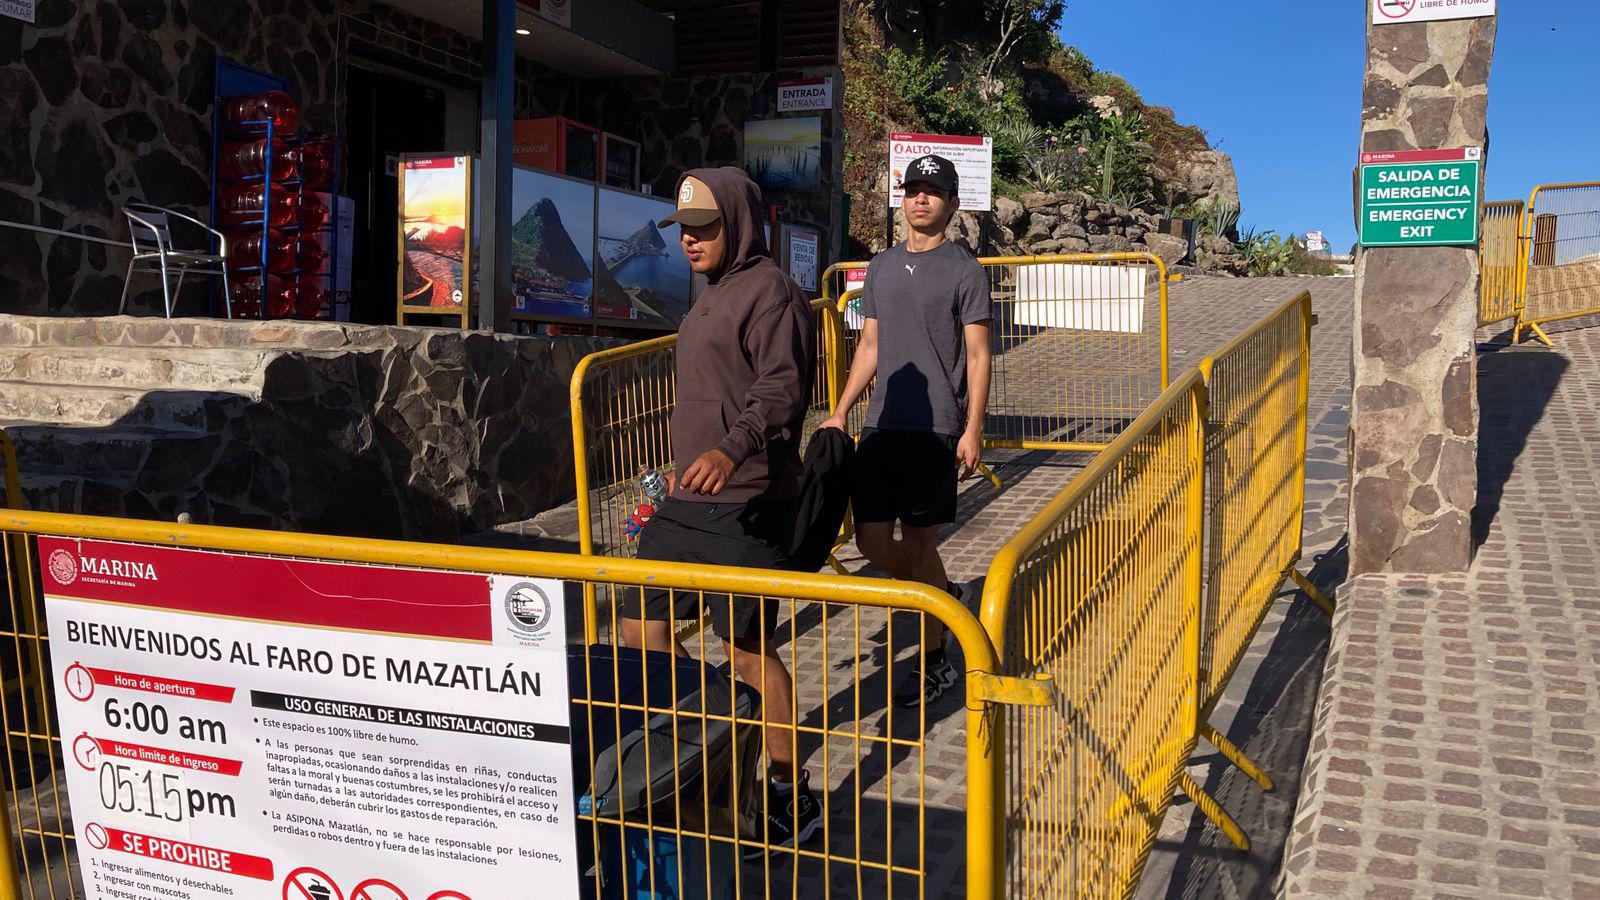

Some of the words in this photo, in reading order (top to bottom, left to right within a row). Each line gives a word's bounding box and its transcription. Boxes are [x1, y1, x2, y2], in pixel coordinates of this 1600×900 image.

[782, 89, 826, 98] ENTRADA
[782, 99, 826, 108] ENTRANCE
[905, 146, 931, 154] ALTO
[1378, 170, 1434, 182] SALIDA
[1438, 168, 1460, 180] DE
[1367, 185, 1471, 199] EMERGENCIA
[1370, 208, 1467, 222] EMERGENCY
[1400, 226, 1434, 237] EXIT
[794, 243, 807, 252] VENTA
[794, 253, 813, 264] BEBIDAS
[80, 556, 158, 580] MARINA
[66, 620, 222, 662] BIENVENIDOS
[230, 641, 259, 667] AL
[266, 646, 333, 674] FARO
[342, 653, 376, 680] DE
[386, 658, 541, 697] MAZATLÁN
[114, 675, 137, 689] Hora
[139, 678, 151, 690] de
[153, 682, 195, 696] apertura
[104, 698, 168, 735] 6:00
[179, 715, 227, 745] am
[263, 718, 280, 728] Este
[282, 722, 314, 734] espacio
[316, 726, 326, 734] es
[328, 726, 352, 738] 100%
[354, 729, 374, 740] libre
[376, 732, 387, 742] de
[389, 734, 418, 746] humo.
[284, 697, 311, 712] USO
[314, 701, 375, 720] GENERAL
[378, 708, 395, 722] DE
[399, 710, 422, 726] LAS
[426, 714, 535, 738] INSTALACIONES
[115, 745, 137, 757] Hora
[139, 747, 166, 763] limite
[168, 753, 180, 765] de
[183, 756, 219, 771] ingreso
[265, 738, 271, 747] A
[277, 740, 289, 750] las
[294, 744, 334, 756] personas
[339, 749, 356, 759] que
[362, 753, 383, 762] sean
[389, 756, 449, 771] sorprendidas
[456, 764, 467, 773] en
[474, 766, 500, 778] riñas,
[507, 771, 557, 784] conductas
[266, 751, 324, 768] inapropiadas,
[325, 760, 381, 774] ocasionando
[383, 766, 410, 778] daños
[421, 771, 433, 781] las
[436, 774, 498, 790] instalaciones
[499, 781, 516, 793] y/o
[519, 784, 558, 797] realicen
[267, 763, 290, 775] faltas
[299, 767, 306, 777] la
[309, 770, 333, 780] moral
[335, 775, 340, 784] y
[342, 774, 374, 787] buenas
[376, 778, 431, 795] costumbres,
[445, 788, 458, 798] les
[461, 791, 504, 804] prohibirá
[506, 795, 515, 805] el
[517, 800, 550, 810] acceso
[552, 803, 558, 812] y
[100, 761, 183, 822] 05:15
[187, 787, 236, 818] pm
[268, 776, 291, 787] serán
[294, 778, 333, 793] turnadas
[344, 786, 356, 797] las
[360, 789, 414, 806] autoridades
[417, 799, 501, 817] correspondientes,
[504, 810, 516, 818] en
[520, 812, 543, 822] caso
[546, 814, 558, 823] de
[270, 788, 292, 800] algún
[294, 792, 318, 805] daño,
[320, 796, 356, 809] deberán
[358, 802, 383, 813] cubrir
[386, 805, 399, 815] los
[400, 809, 429, 820] gastos
[431, 812, 443, 822] de
[445, 816, 498, 829] reparación.
[272, 811, 281, 820] La
[286, 813, 325, 828] ASIPONA
[328, 820, 372, 835] Mazatlán,
[408, 832, 430, 843] hace
[435, 838, 492, 852] responsable
[497, 846, 513, 855] por
[519, 847, 562, 863] lesiones,
[273, 824, 309, 836] perdidas
[318, 832, 343, 842] robos
[344, 836, 373, 848] dentro
[375, 841, 380, 850] y
[383, 841, 406, 852] fuera
[408, 844, 420, 854] de
[422, 846, 435, 856] las
[437, 849, 498, 866] instalaciones
[123, 834, 144, 854] SE
[149, 839, 232, 872] PROHIBE
[91, 858, 99, 866] 1.
[102, 860, 132, 874] Ingresar
[135, 868, 174, 882] alimentos
[175, 877, 180, 886] y
[183, 878, 233, 895] desechables
[93, 871, 101, 879] 2.
[104, 873, 134, 887] Ingresar
[137, 882, 150, 890] con
[153, 886, 190, 900] mascotas
[96, 884, 103, 892] 3.
[106, 886, 136, 900] Ingresar
